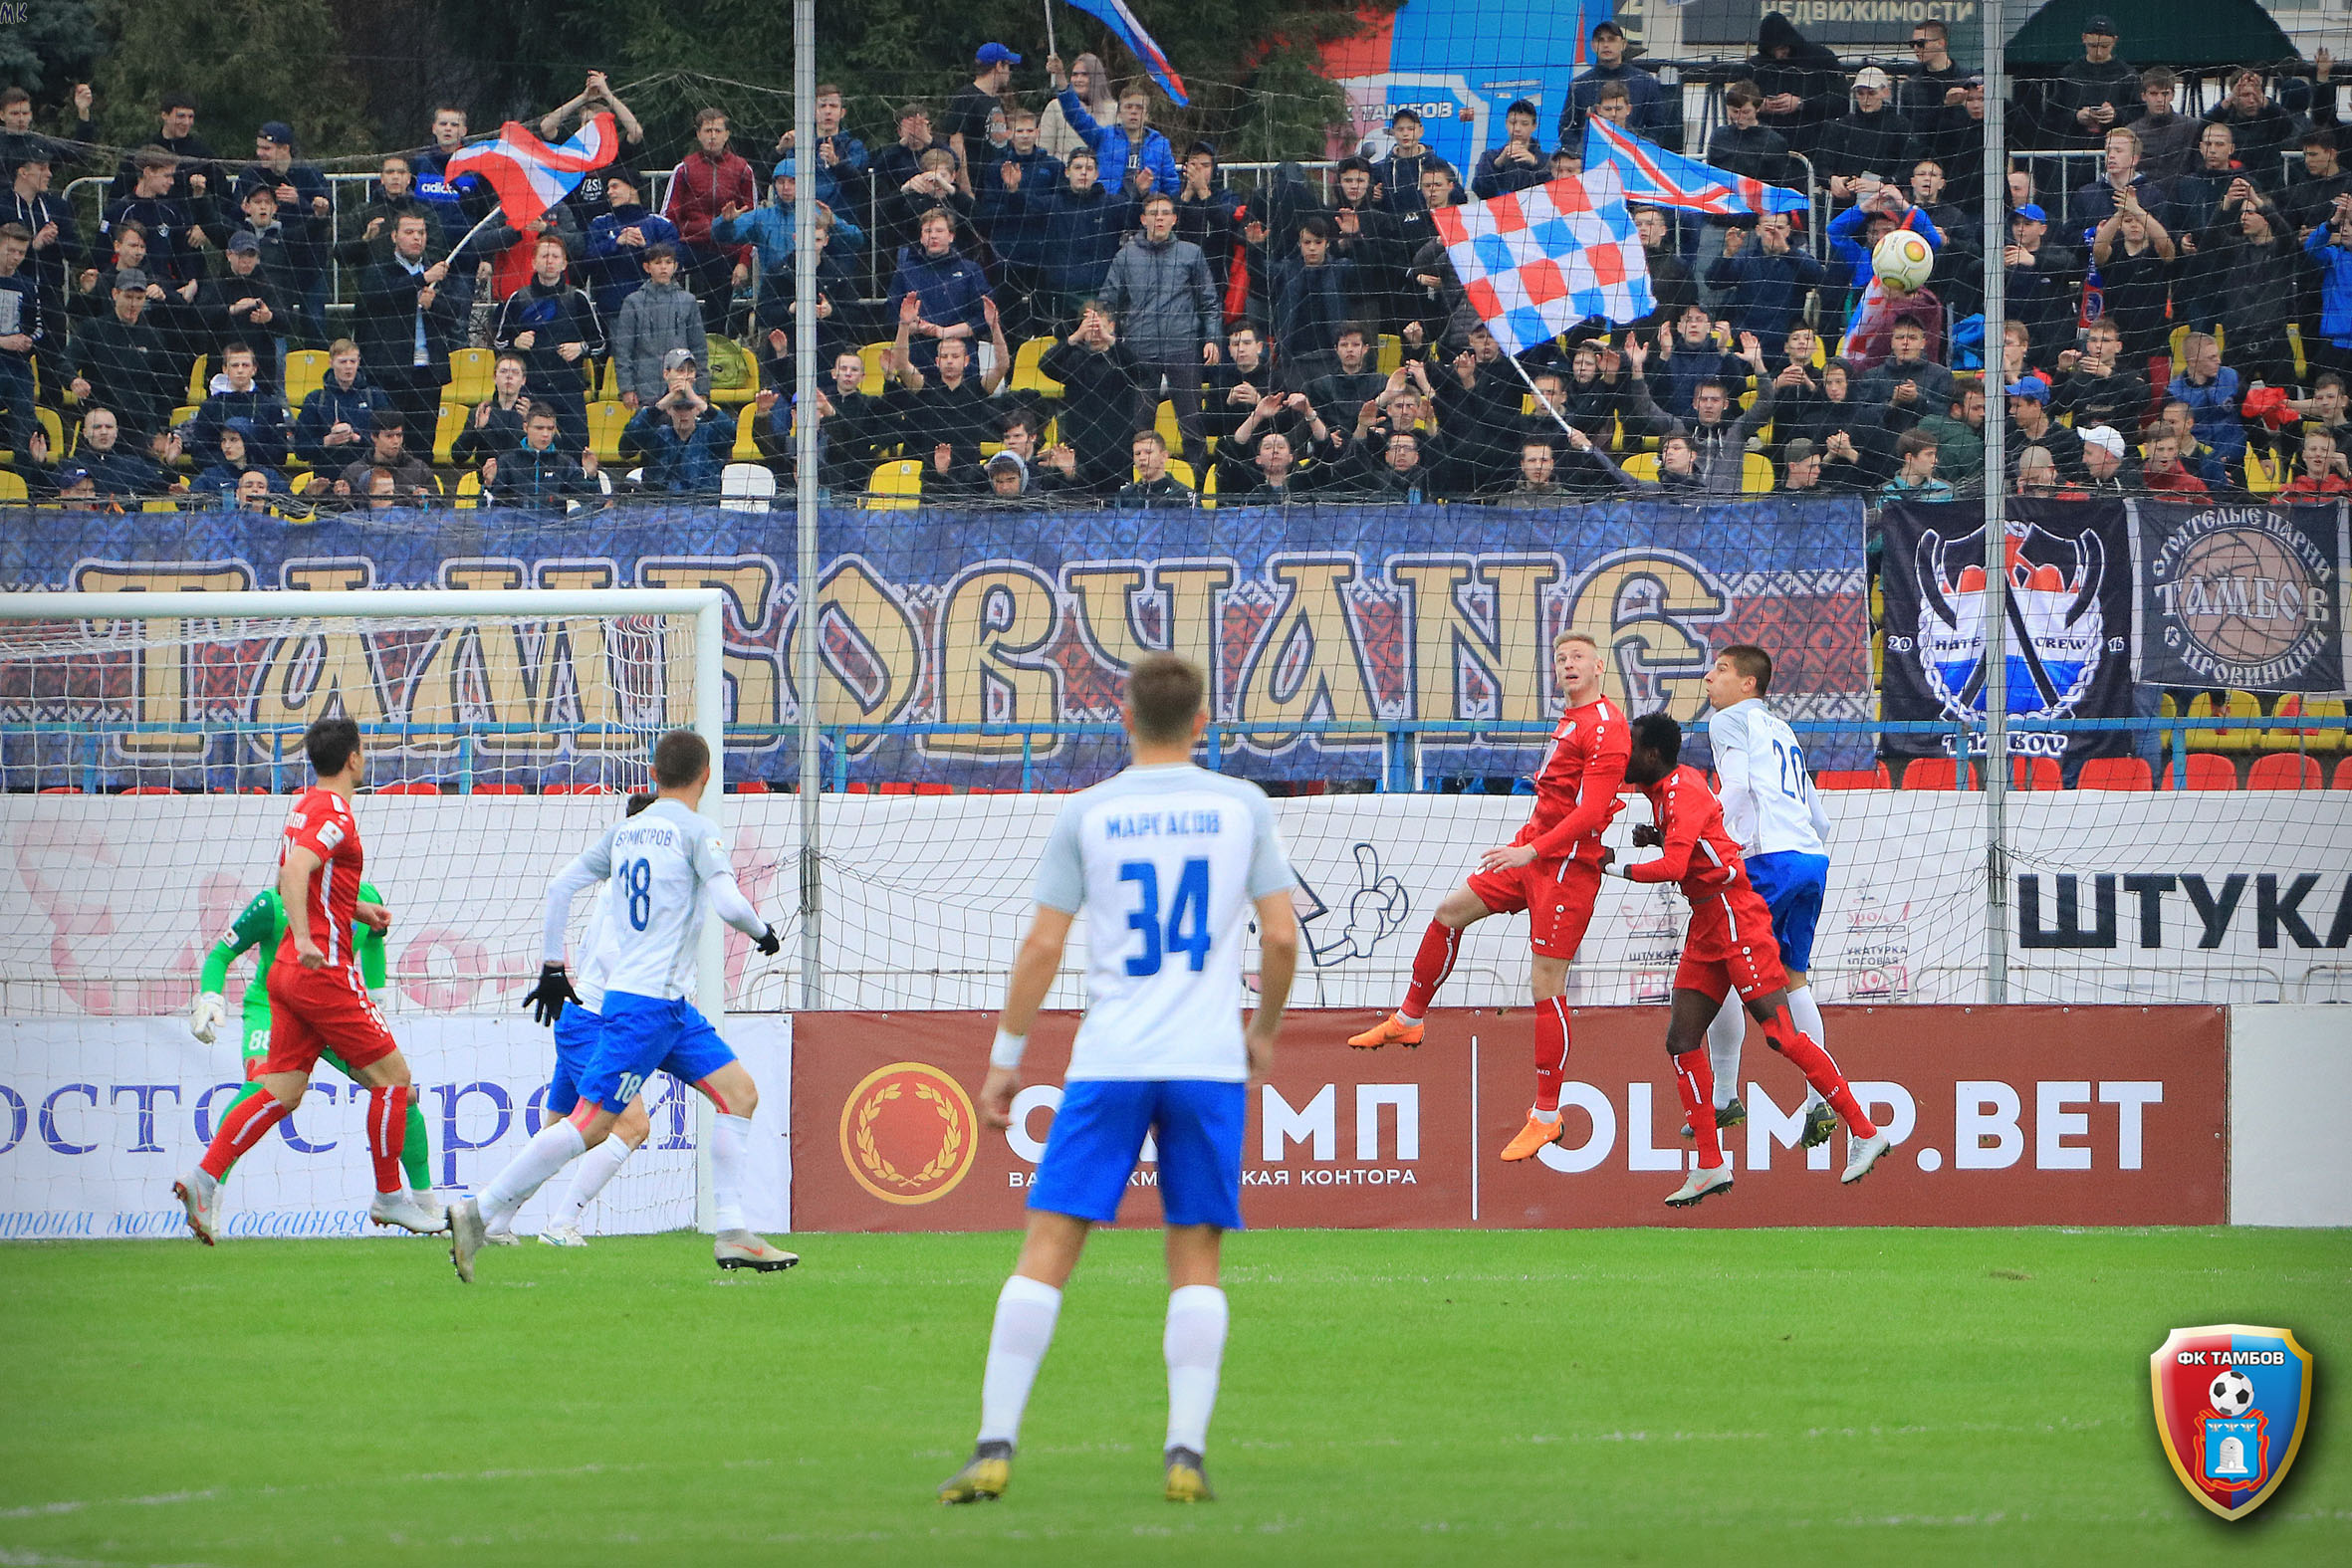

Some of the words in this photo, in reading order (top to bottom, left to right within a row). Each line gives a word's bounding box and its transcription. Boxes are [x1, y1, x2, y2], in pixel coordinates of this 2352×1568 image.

[1761, 1, 1974, 25] НЕДВИЖИМОСТИ
[2153, 574, 2331, 622] ТАМБОВ
[1888, 636, 1913, 651] 20
[2034, 636, 2088, 650] CREW
[1772, 739, 1806, 805] 20
[1106, 809, 1221, 838] МАРГАСОВ
[618, 857, 650, 932] 18
[1119, 858, 1211, 978] 34
[613, 1072, 642, 1105] 18
[1004, 1083, 1420, 1162] ОМП
[1299, 1169, 1418, 1186] КОНТОРА
